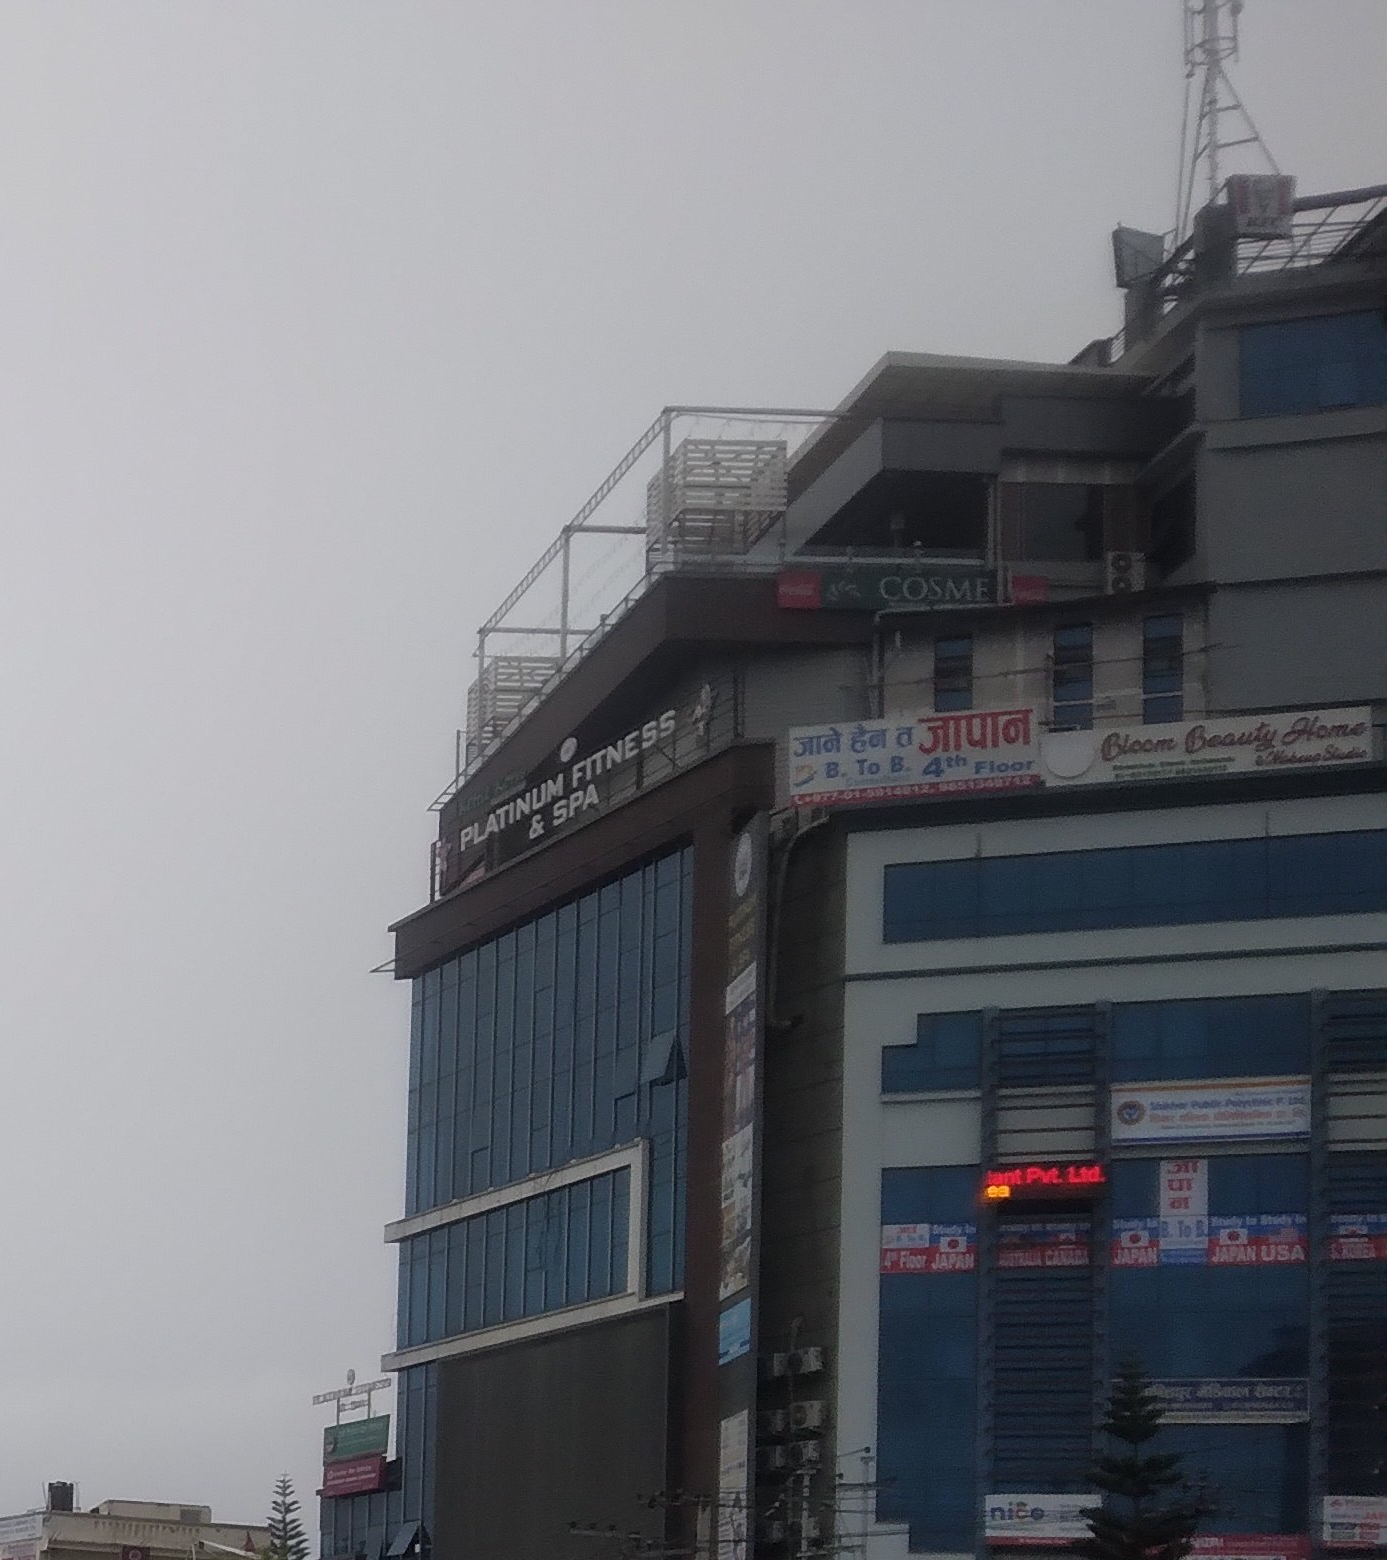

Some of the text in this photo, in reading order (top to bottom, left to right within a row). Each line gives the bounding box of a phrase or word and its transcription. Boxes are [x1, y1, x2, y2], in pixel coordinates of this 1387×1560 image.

[918, 709, 1033, 756] जापान
[1101, 716, 1366, 762] Bloom Beauty Home
[857, 758, 881, 776] To
[923, 754, 969, 778] 4th
[974, 759, 1036, 775] Floor
[460, 773, 564, 852] PLATINUM
[571, 709, 676, 789] FITNESS
[529, 813, 545, 840] &
[552, 783, 599, 827] SPA
[1026, 1167, 1063, 1184] Pvt.
[1068, 1165, 1107, 1184] Ltd.
[930, 1251, 975, 1271] JAPAN
[1115, 1247, 1158, 1265] JAPAN
[1211, 1244, 1306, 1263] JAPAN USA
